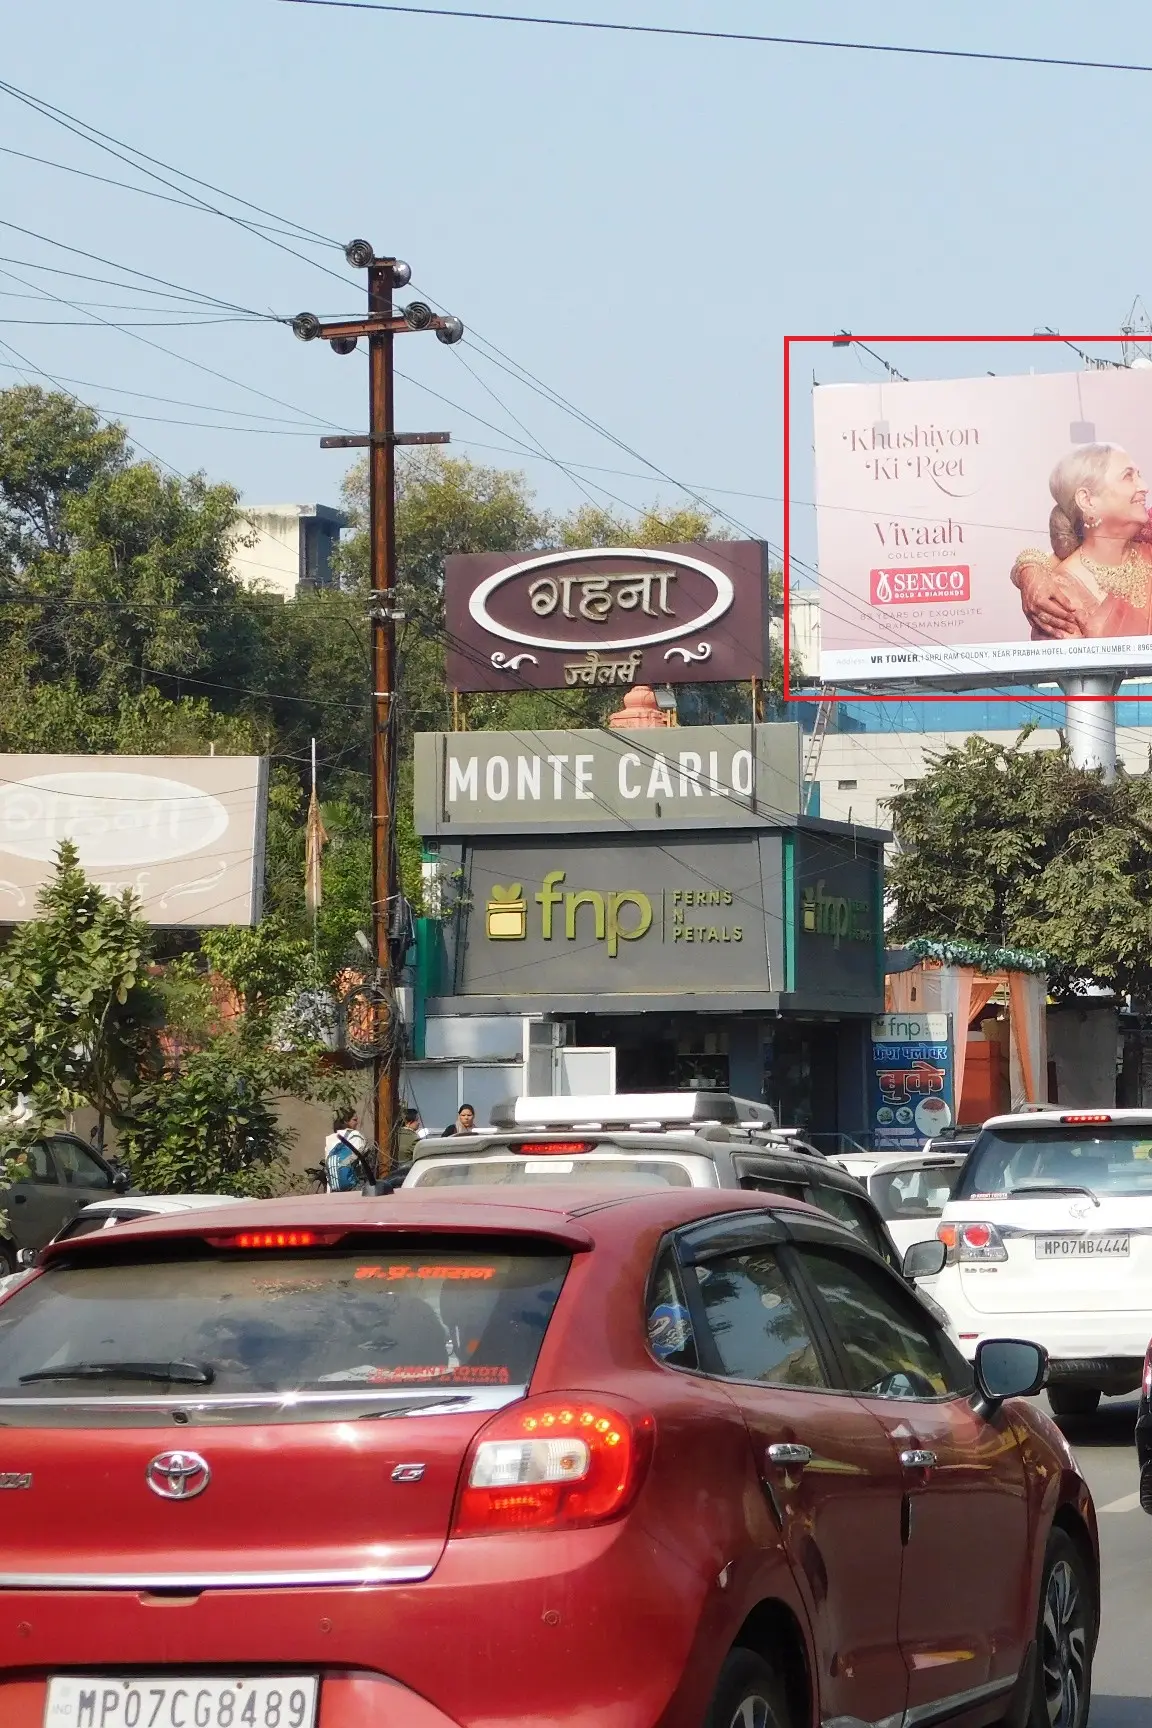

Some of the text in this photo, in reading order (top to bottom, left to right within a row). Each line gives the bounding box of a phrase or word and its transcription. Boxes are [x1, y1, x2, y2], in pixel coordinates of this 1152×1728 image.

[842, 424, 980, 453] Khushiyon
[866, 455, 982, 498] Ki Reet
[874, 518, 964, 547] Vivaah
[888, 550, 956, 560] COLLECTION
[894, 571, 964, 591] SENCO
[528, 569, 677, 622] गहना
[877, 611, 909, 620] YEARS
[912, 610, 925, 618] OF
[929, 608, 983, 618] EXQUISITE
[878, 619, 965, 630] CRAFTSMANSHIP
[870, 655, 883, 664] VR
[943, 652, 959, 660] RAM
[992, 649, 1010, 658] NEAR
[1012, 648, 1040, 657] PRABHA
[1068, 646, 1100, 654] CONTACT
[1101, 645, 1131, 653] NUMBER
[449, 749, 753, 802] MONTE CARLO
[672, 890, 733, 906] FERNS
[535, 870, 653, 958] fnp
[672, 909, 685, 924] N
[672, 927, 744, 944] PETALS
[888, 1017, 921, 1040] fnp
[77, 1689, 306, 1728] MP07CG8489
